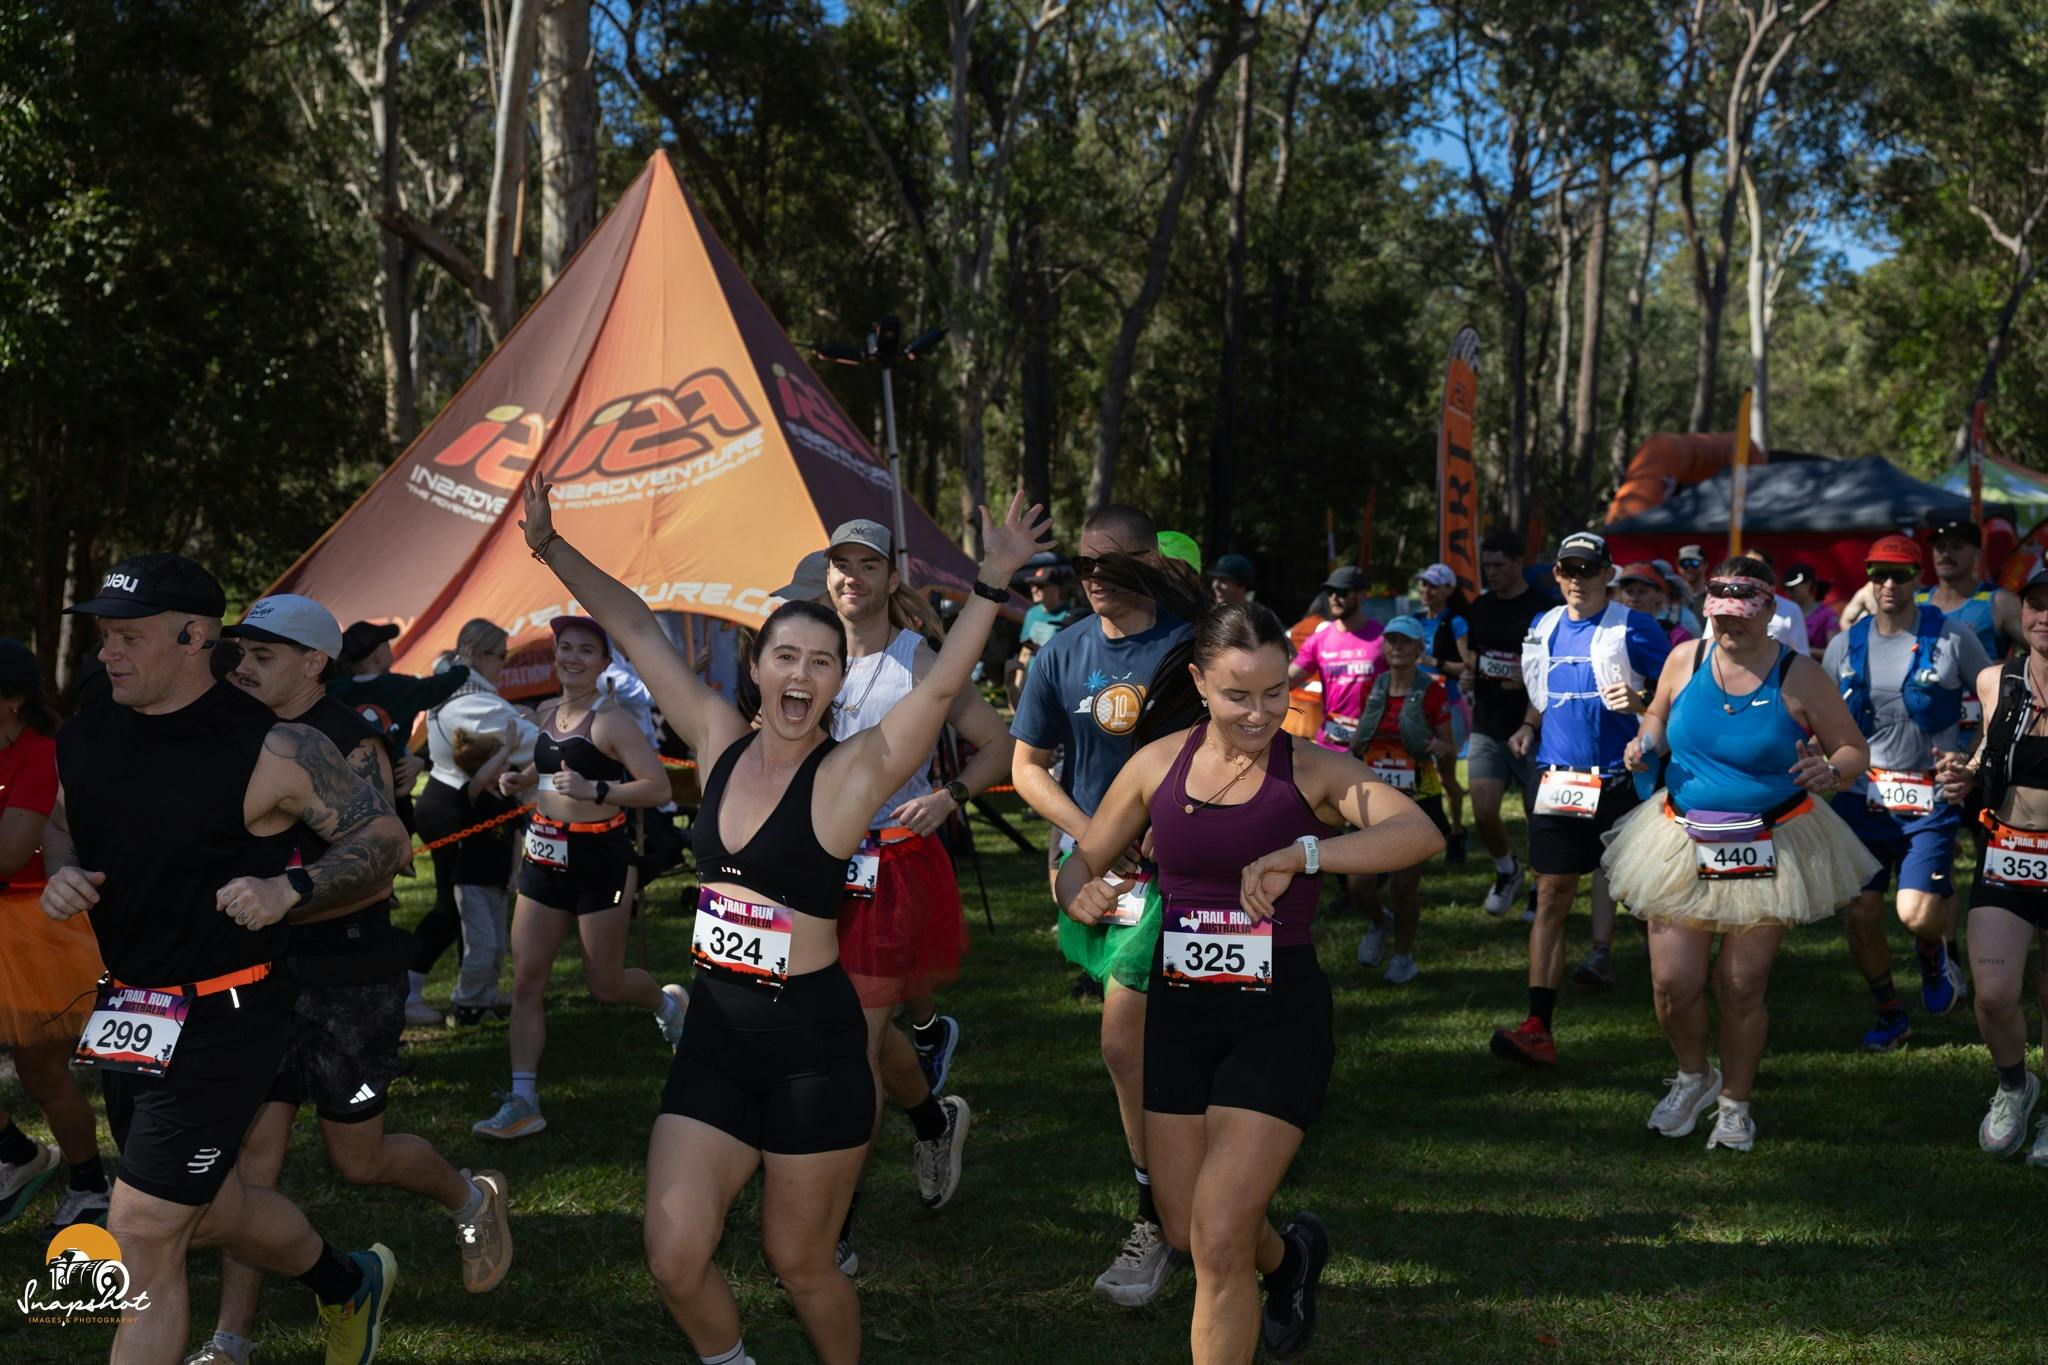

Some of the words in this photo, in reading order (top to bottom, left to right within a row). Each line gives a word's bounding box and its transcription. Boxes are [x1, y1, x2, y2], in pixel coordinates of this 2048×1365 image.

[550, 427, 764, 502] N2ADVENTURE
[1113, 694, 1128, 718] 10
[1551, 789, 1584, 807] 402
[1880, 786, 1918, 805] 406
[530, 838, 556, 861] 322
[1713, 846, 1758, 867] 440
[2002, 856, 2048, 880] 353
[723, 897, 749, 918] TRAIL
[751, 904, 775, 921] RUN
[1196, 910, 1227, 924] TRAIL
[723, 911, 773, 930] AUSTRALIA
[1198, 923, 1252, 935] AUSTRALIA
[709, 926, 763, 966] 324
[1185, 942, 1245, 973] 325
[121, 1001, 167, 1016] AUSTRALIA
[124, 989, 145, 1004] TRAIL
[148, 992, 173, 1008] RUN
[96, 1019, 152, 1052] 299
